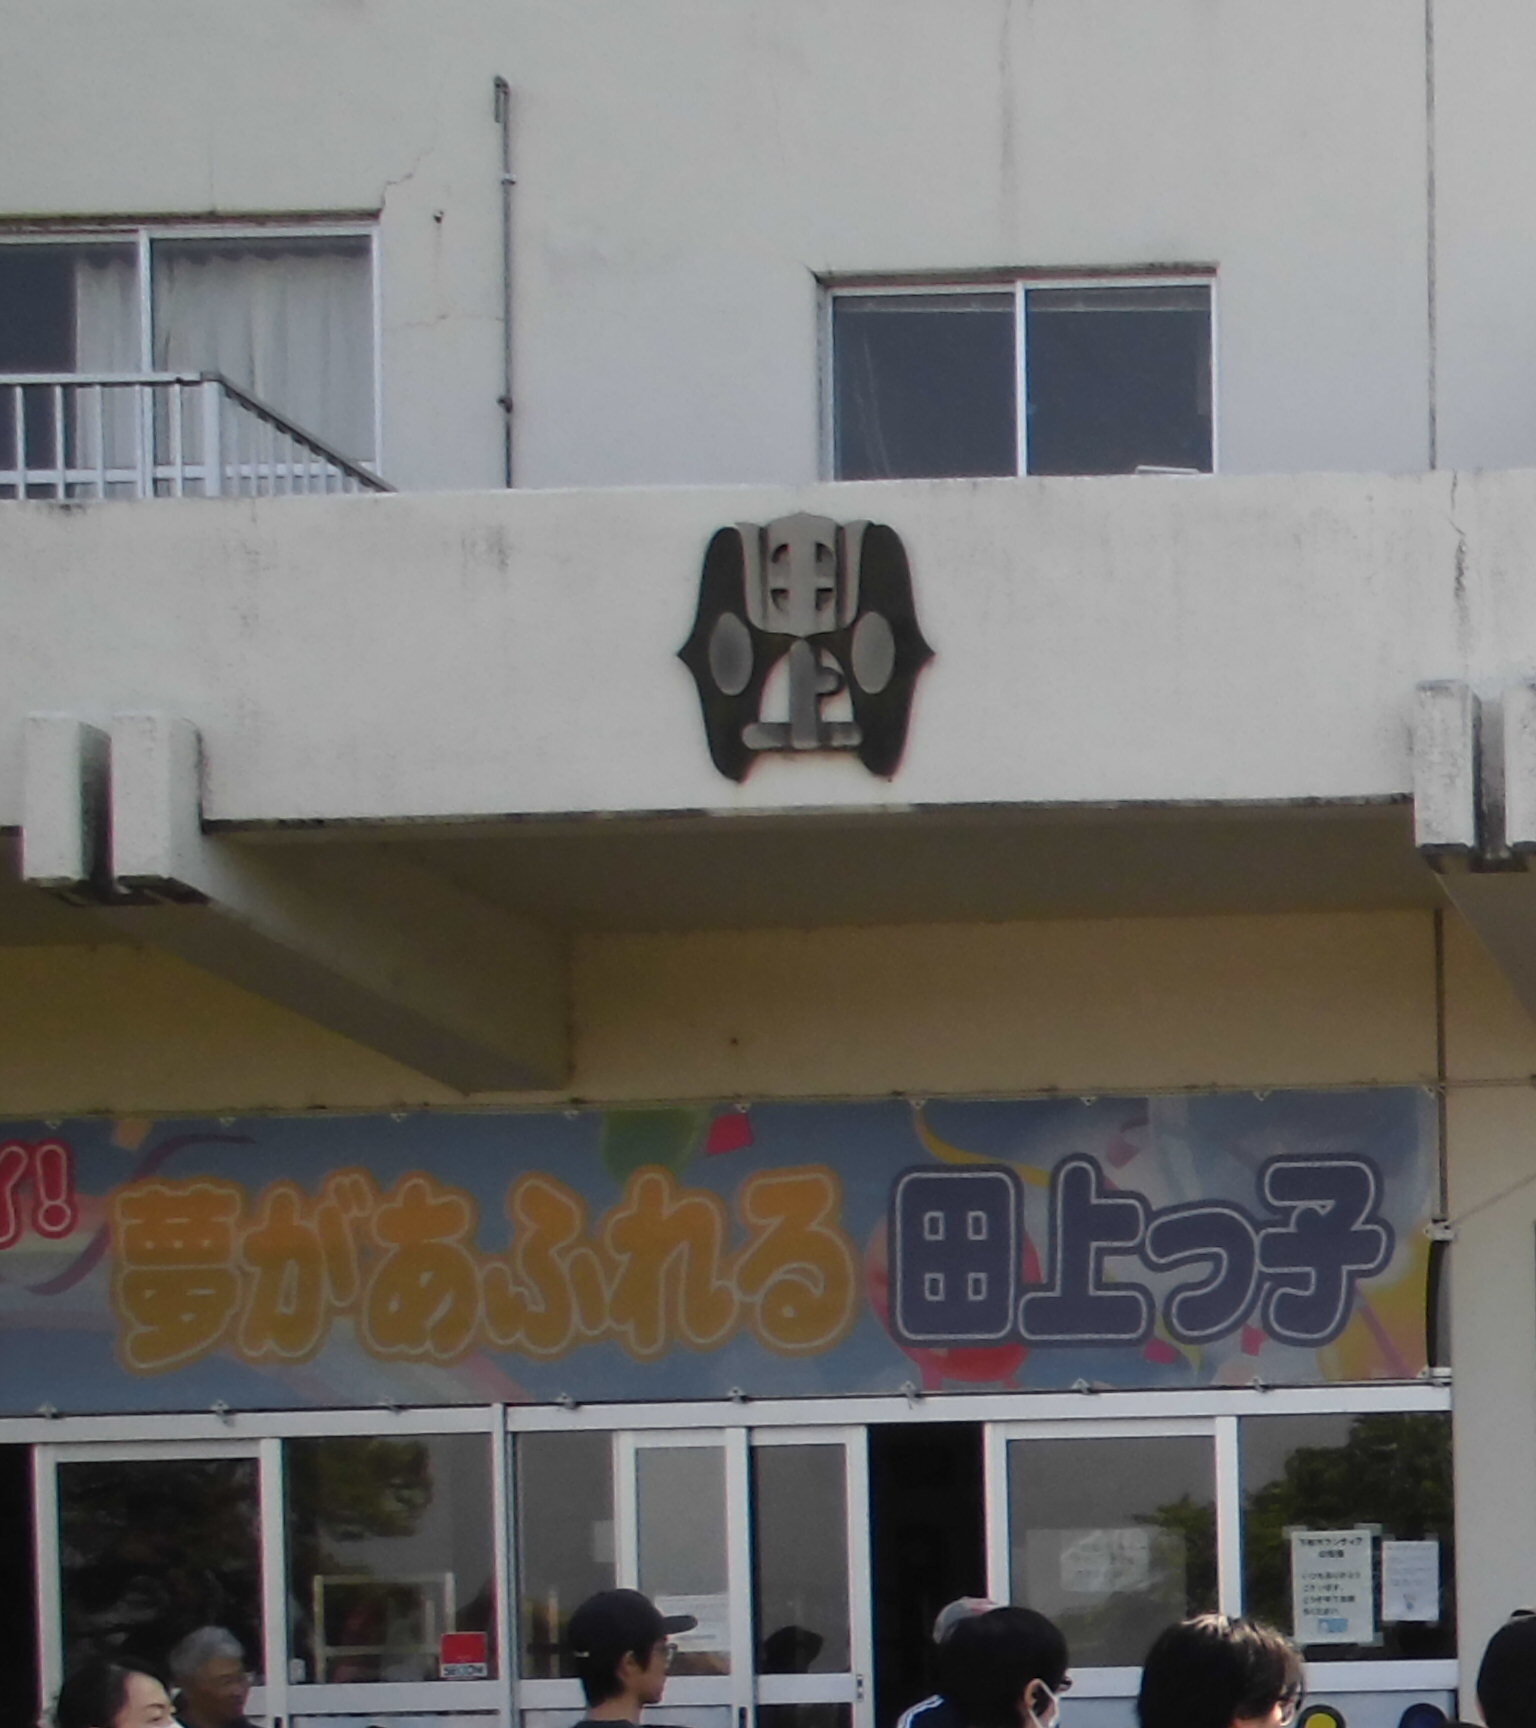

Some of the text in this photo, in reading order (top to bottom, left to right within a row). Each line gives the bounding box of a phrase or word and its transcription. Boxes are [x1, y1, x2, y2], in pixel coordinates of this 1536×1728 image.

[111, 1154, 1394, 1374] 夢があふれる 田上っ子
